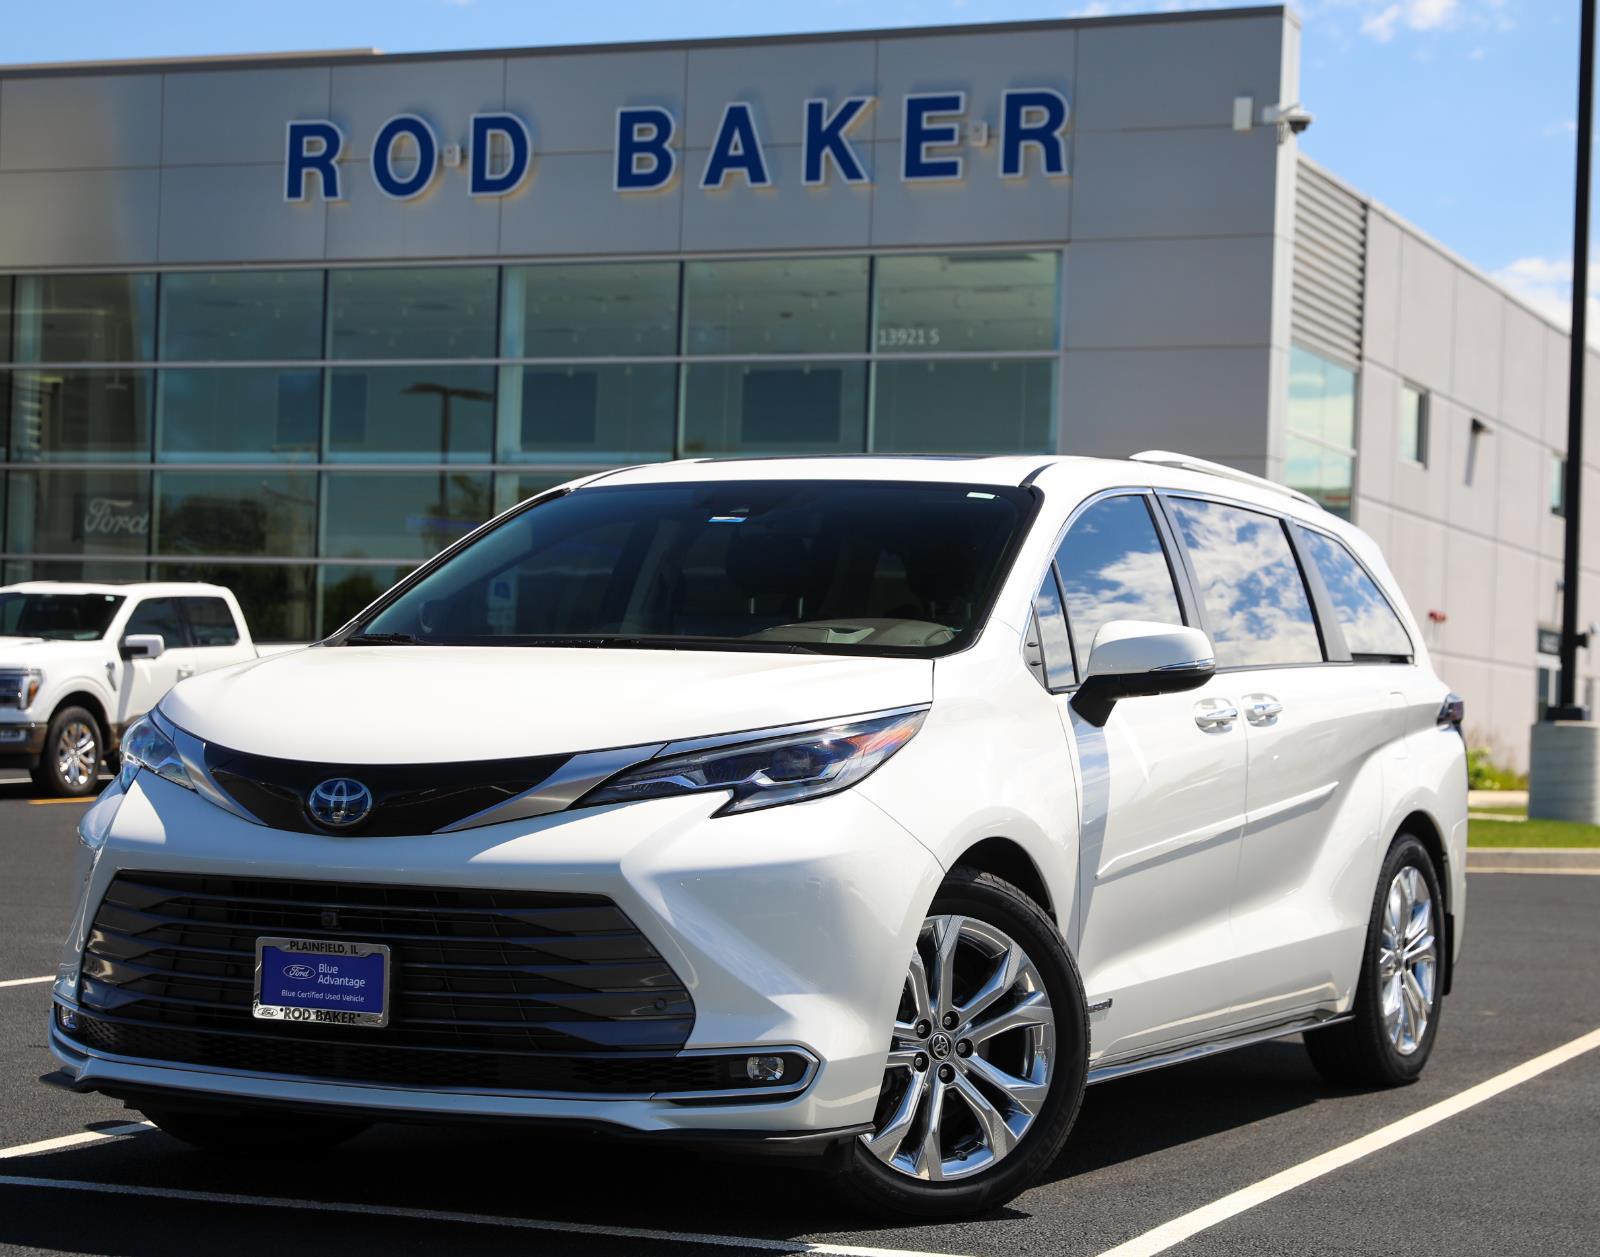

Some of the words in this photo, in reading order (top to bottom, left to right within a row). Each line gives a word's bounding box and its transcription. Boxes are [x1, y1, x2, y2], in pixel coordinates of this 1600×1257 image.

[284, 112, 532, 202] ROD
[613, 88, 1070, 192] BAKER
[880, 327, 925, 346] 13921
[929, 327, 941, 346] S
[84, 497, 149, 535] Ford
[289, 940, 347, 955] PLAINFIELD,
[350, 944, 359, 955] IL
[287, 965, 312, 978] Ford
[318, 963, 339, 974] Blue
[317, 974, 366, 989] Advantage
[281, 989, 296, 997] Blue
[297, 990, 324, 999] Certified
[325, 992, 341, 1001] Used
[342, 994, 365, 1003] Vehicle
[284, 1007, 311, 1021] ROD
[315, 1009, 356, 1024] BAKER
